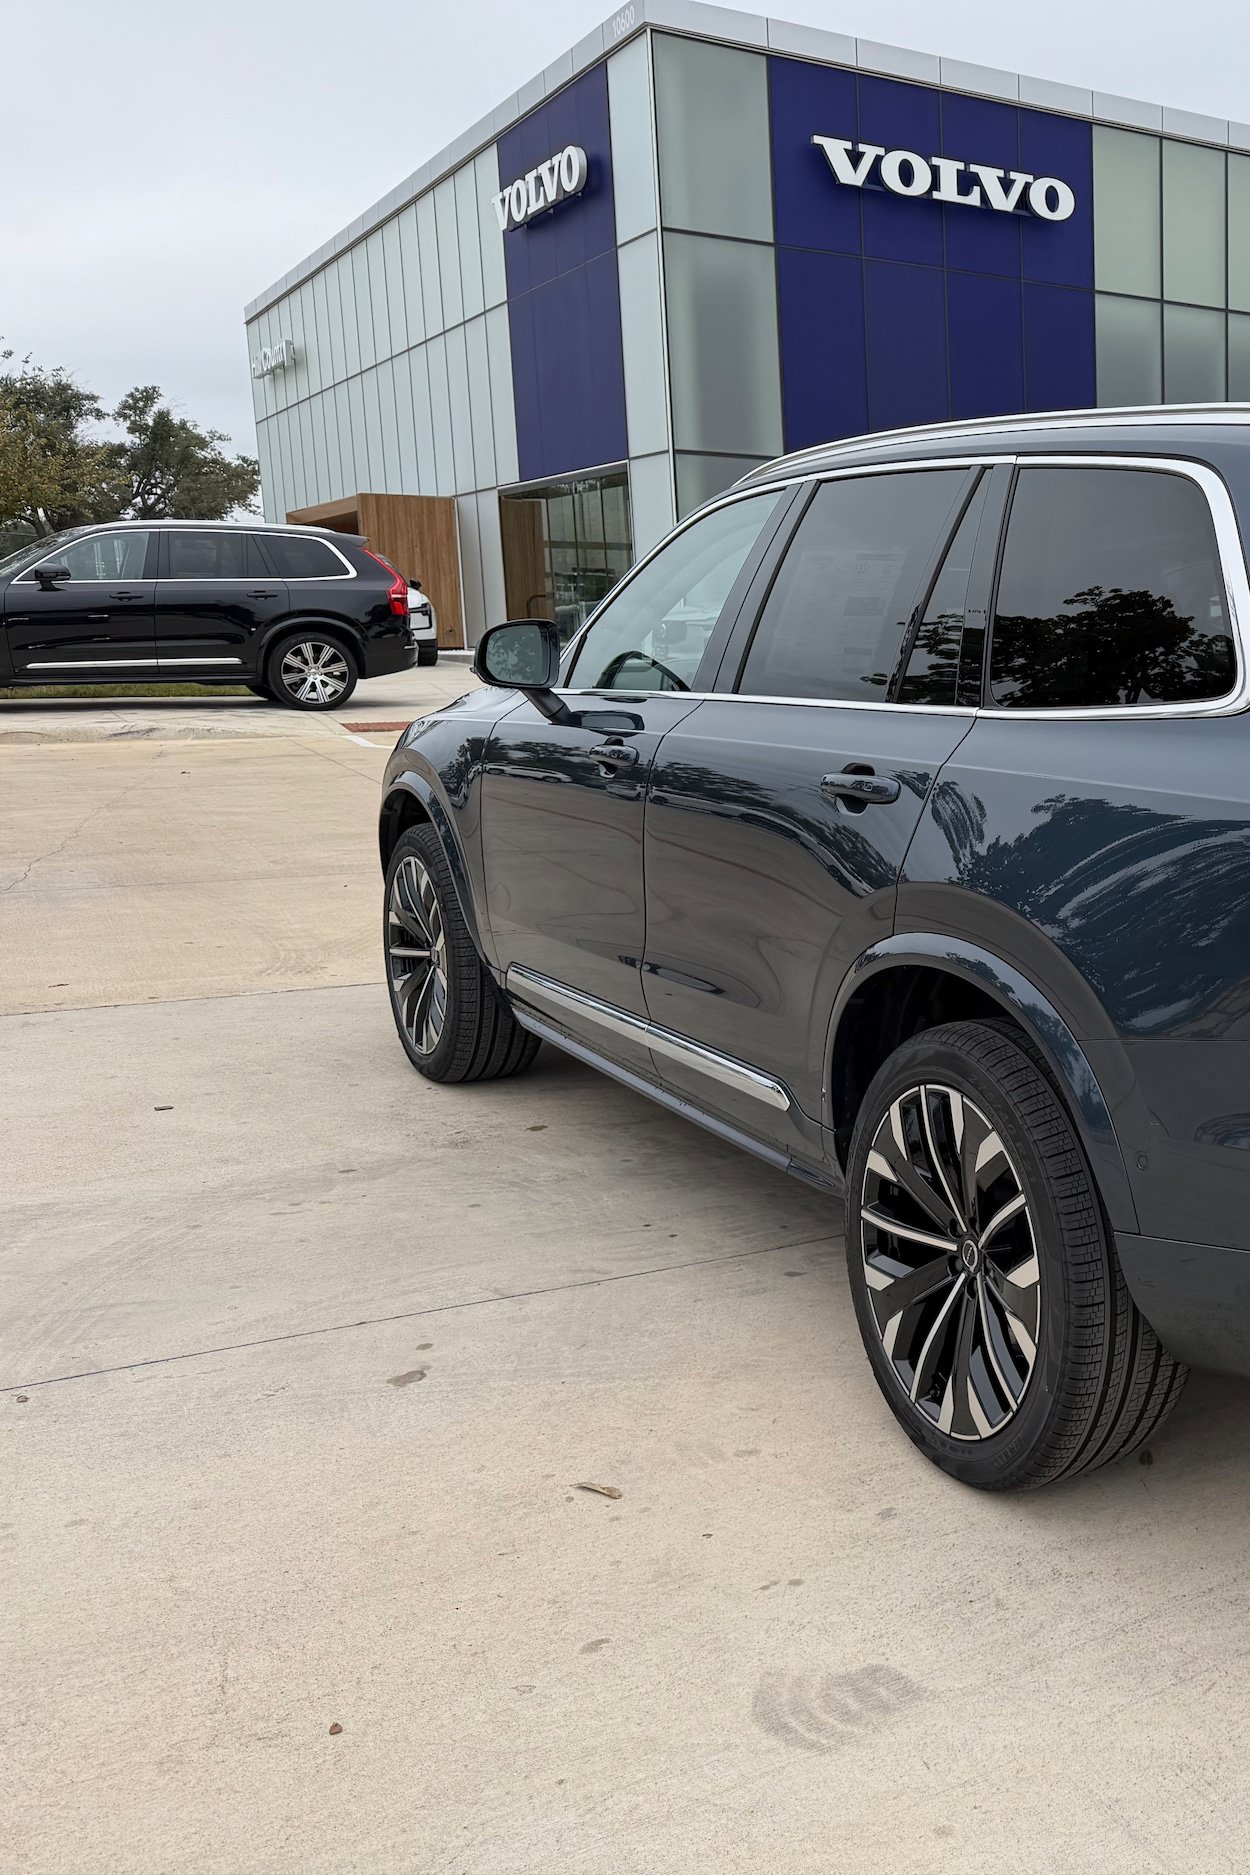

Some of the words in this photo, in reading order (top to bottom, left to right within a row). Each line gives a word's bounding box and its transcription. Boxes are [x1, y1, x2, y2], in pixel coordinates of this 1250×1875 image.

[612, 5, 635, 38] 10600
[491, 145, 583, 231] VOLVO
[812, 134, 1076, 221] VOLVO
